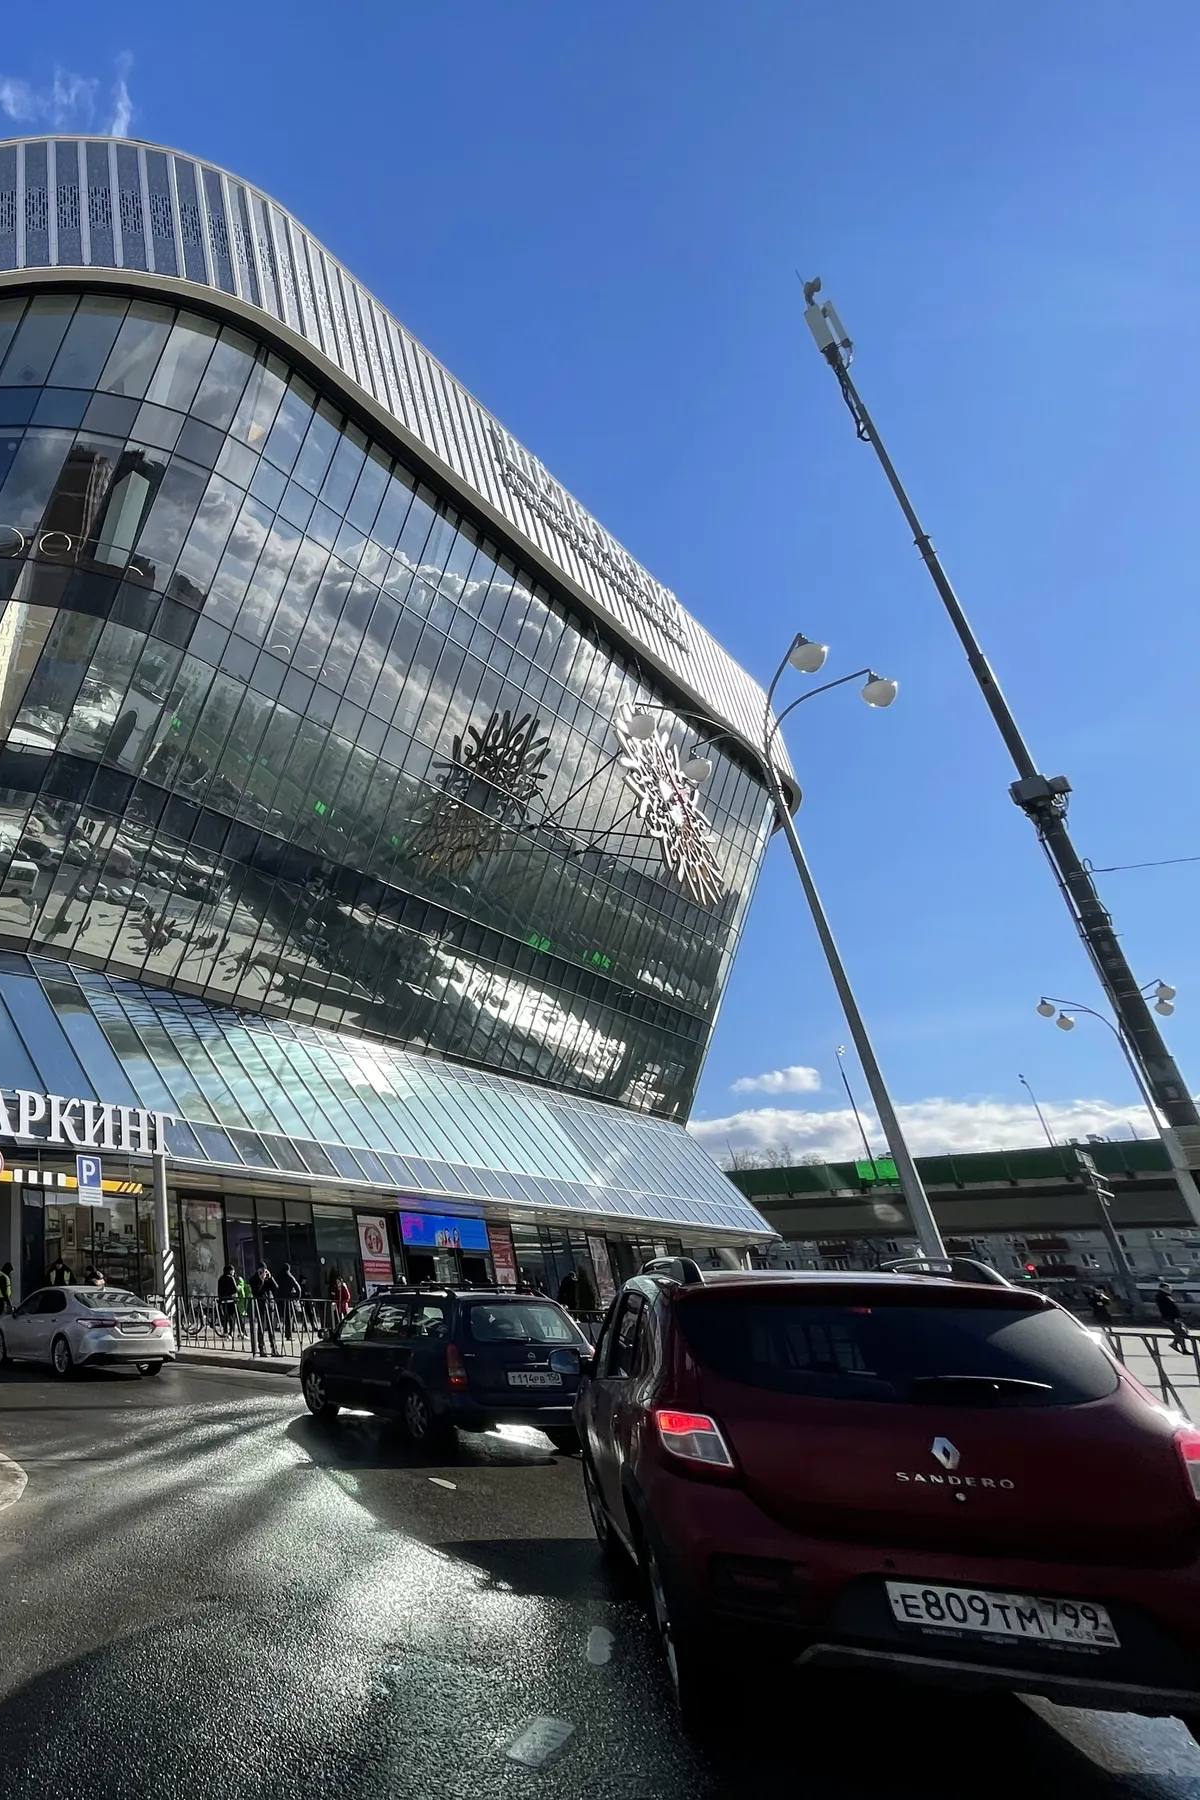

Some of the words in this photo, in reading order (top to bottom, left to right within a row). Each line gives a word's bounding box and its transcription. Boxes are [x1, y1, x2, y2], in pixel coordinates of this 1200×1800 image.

[82, 1159, 96, 1184] P
[895, 1471, 1015, 1489] SANDERO
[1066, 1628, 1095, 1641] RUS
